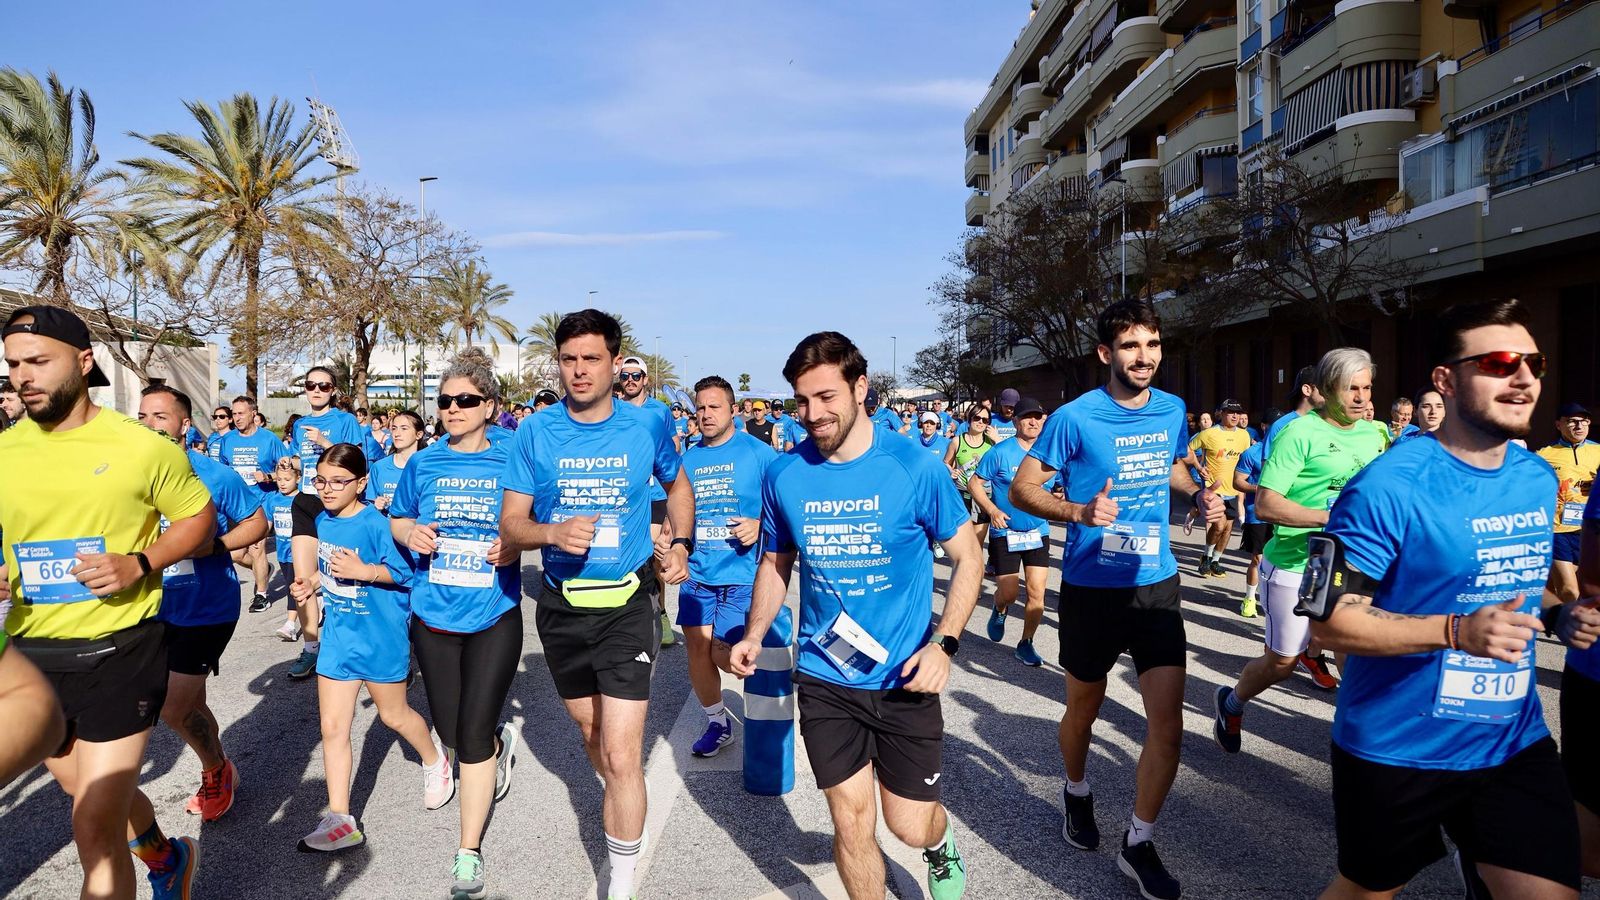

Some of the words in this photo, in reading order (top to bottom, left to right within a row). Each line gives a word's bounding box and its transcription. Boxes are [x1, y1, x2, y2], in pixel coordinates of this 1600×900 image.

[1115, 430, 1168, 447] mayoral
[559, 454, 628, 472] mayoral
[695, 463, 734, 476] mayoral
[436, 478, 498, 489] mayoral
[564, 488, 620, 497] MAKES
[439, 503, 489, 512] MAKES
[805, 495, 880, 516] mayoral
[1471, 506, 1549, 535] mayoral
[706, 527, 727, 538] 583
[811, 534, 871, 545] MAKES
[1121, 536, 1147, 551] 702
[443, 553, 482, 570] 1445
[40, 560, 77, 580] 664
[1472, 674, 1516, 697] 810
